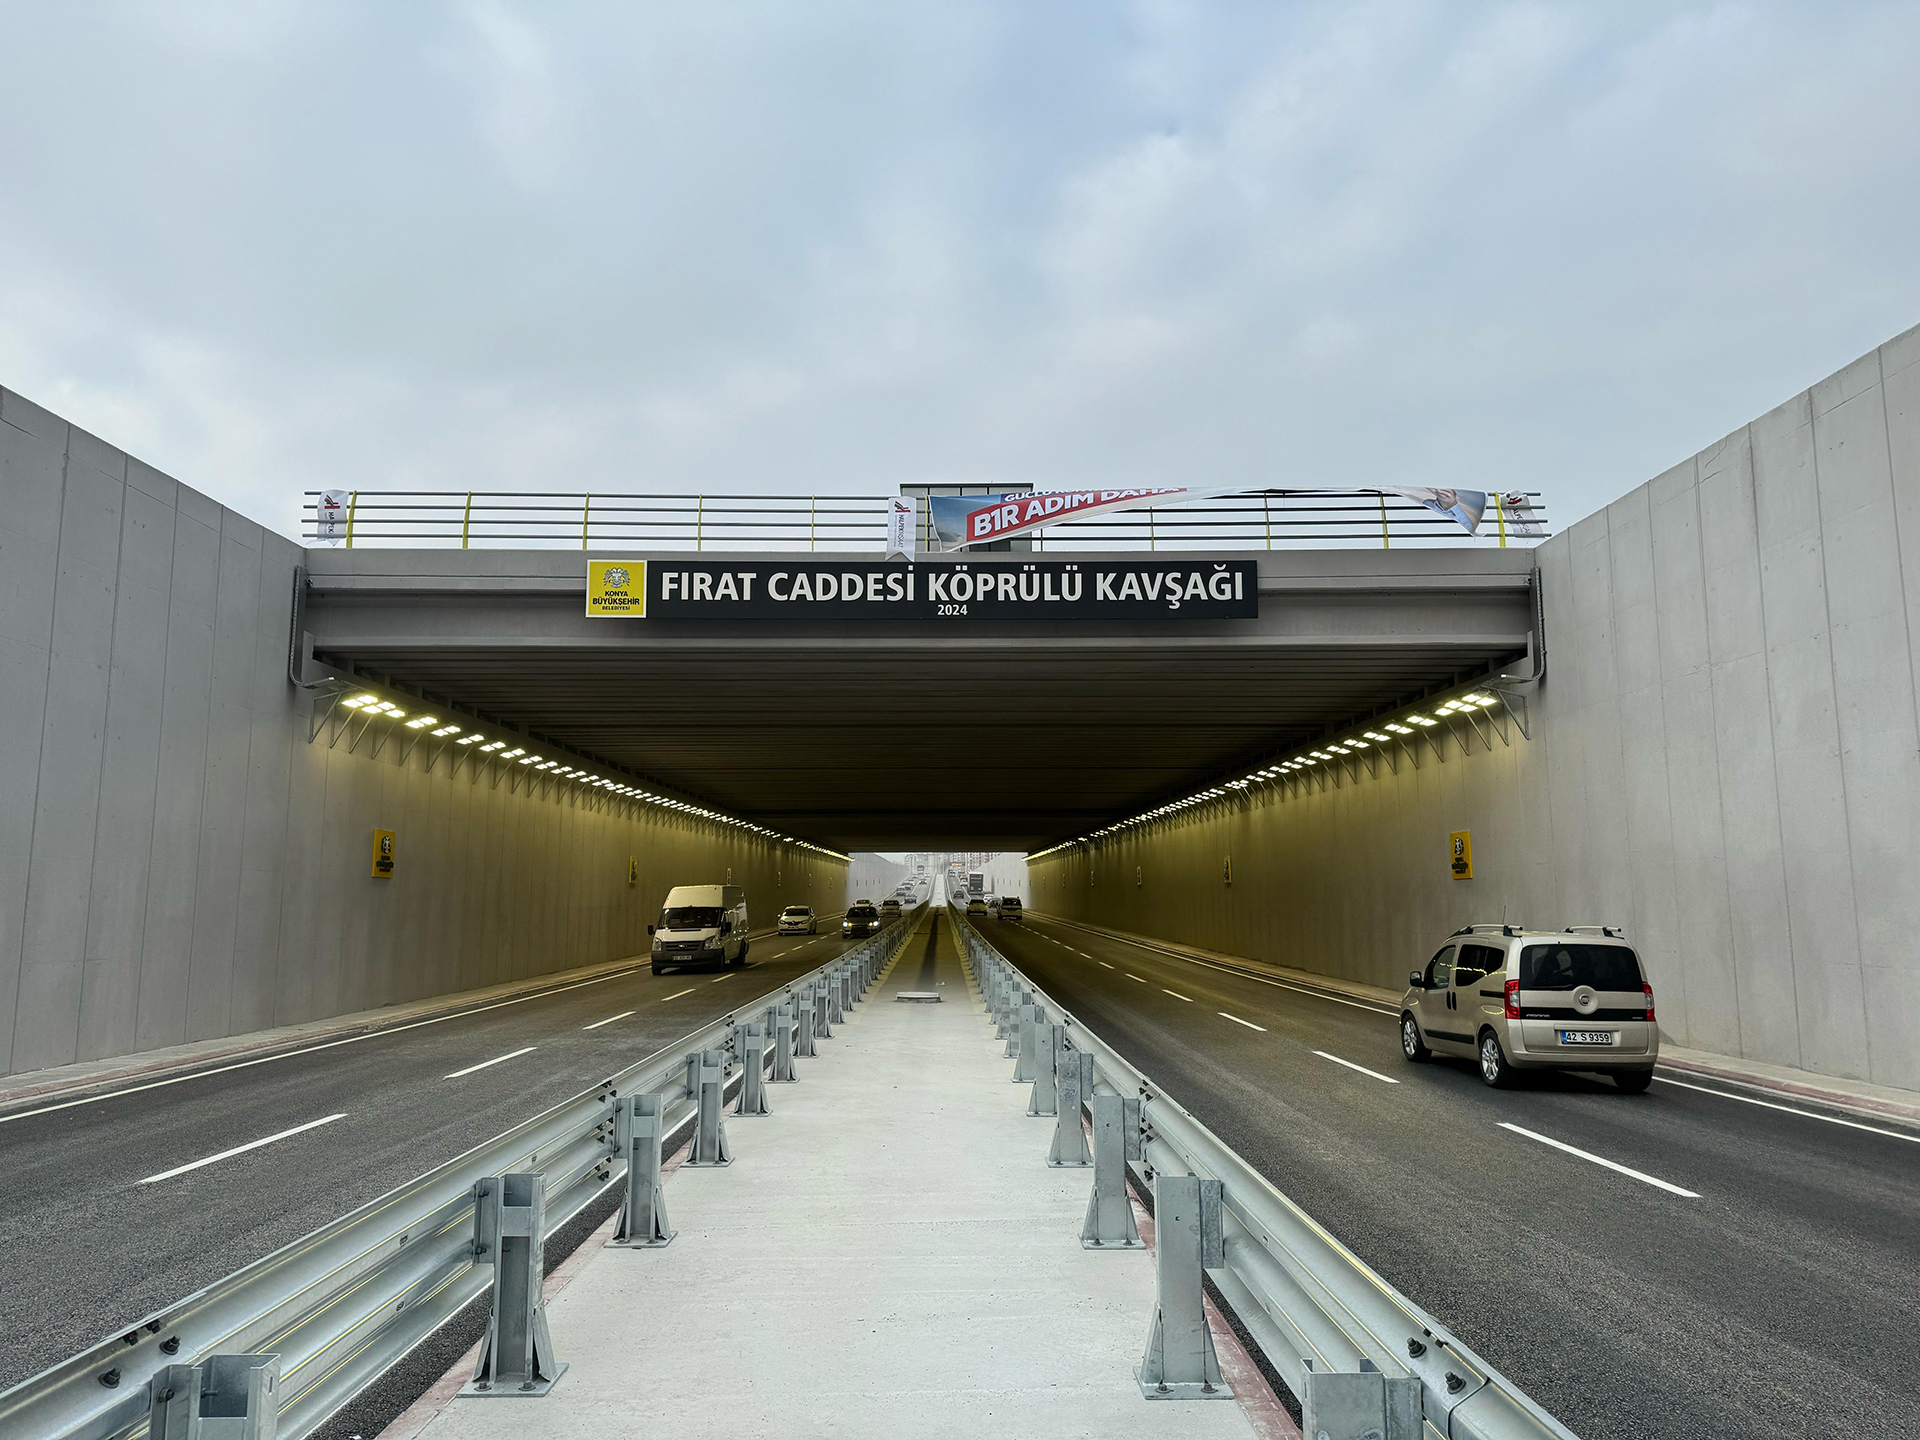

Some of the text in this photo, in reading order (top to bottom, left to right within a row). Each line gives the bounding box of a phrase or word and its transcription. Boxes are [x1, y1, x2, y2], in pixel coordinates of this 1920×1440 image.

[1024, 492, 1094, 521] ADIM
[661, 563, 1244, 610] FIRAT CADDESİ KÖPRÜLÜ KAVŞAĞI
[592, 596, 640, 606] BÜYÜKŞEHİR
[937, 604, 968, 616] 2024
[1566, 1032, 1610, 1043] 42 S 9359
